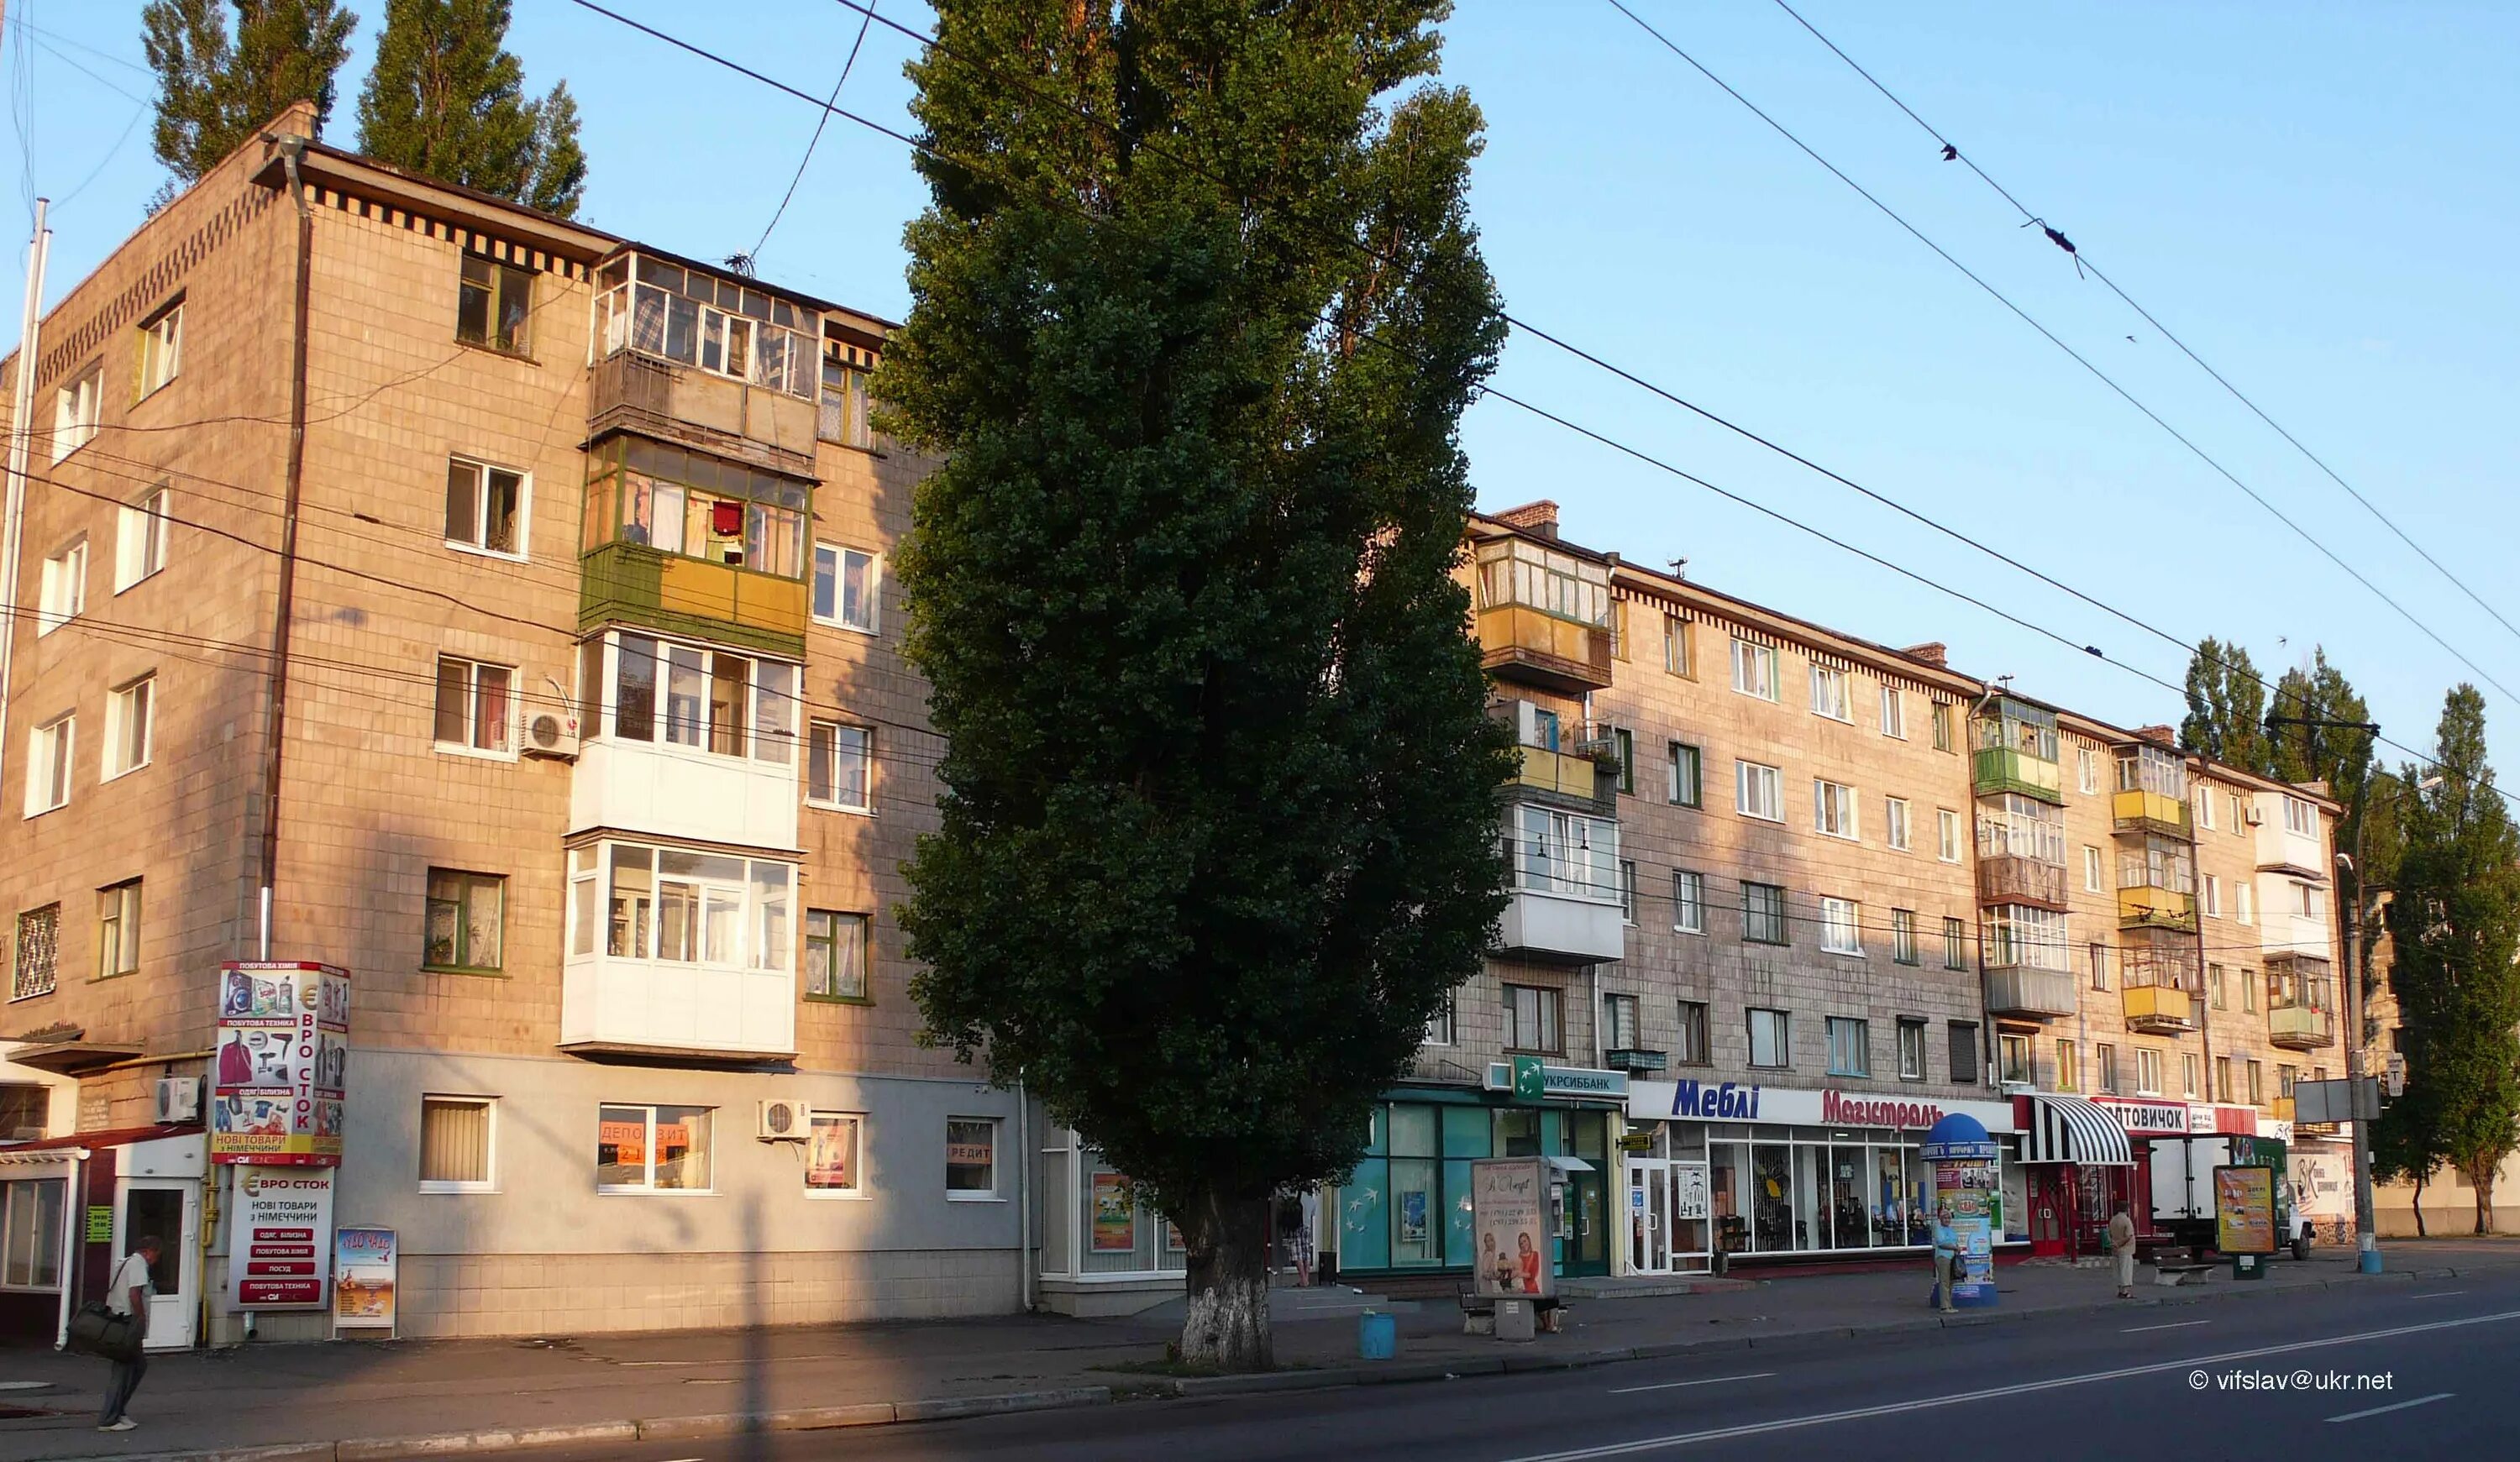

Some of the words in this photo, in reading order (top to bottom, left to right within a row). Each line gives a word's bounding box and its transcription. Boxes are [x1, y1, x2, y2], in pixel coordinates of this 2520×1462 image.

[1543, 1076, 1609, 1090] УКРСИББАНК
[1671, 1079, 1761, 1119] Меблі
[1821, 1089, 1944, 1132] Магістраль
[217, 1136, 242, 1145] НОВІ
[245, 1136, 286, 1145] ТОВАРИ
[293, 1180, 329, 1189] СТОК
[252, 1202, 276, 1210] НОВІ
[278, 1202, 317, 1210] ТОВАРИ
[258, 1213, 318, 1222] НІМЕЧЧИНИ
